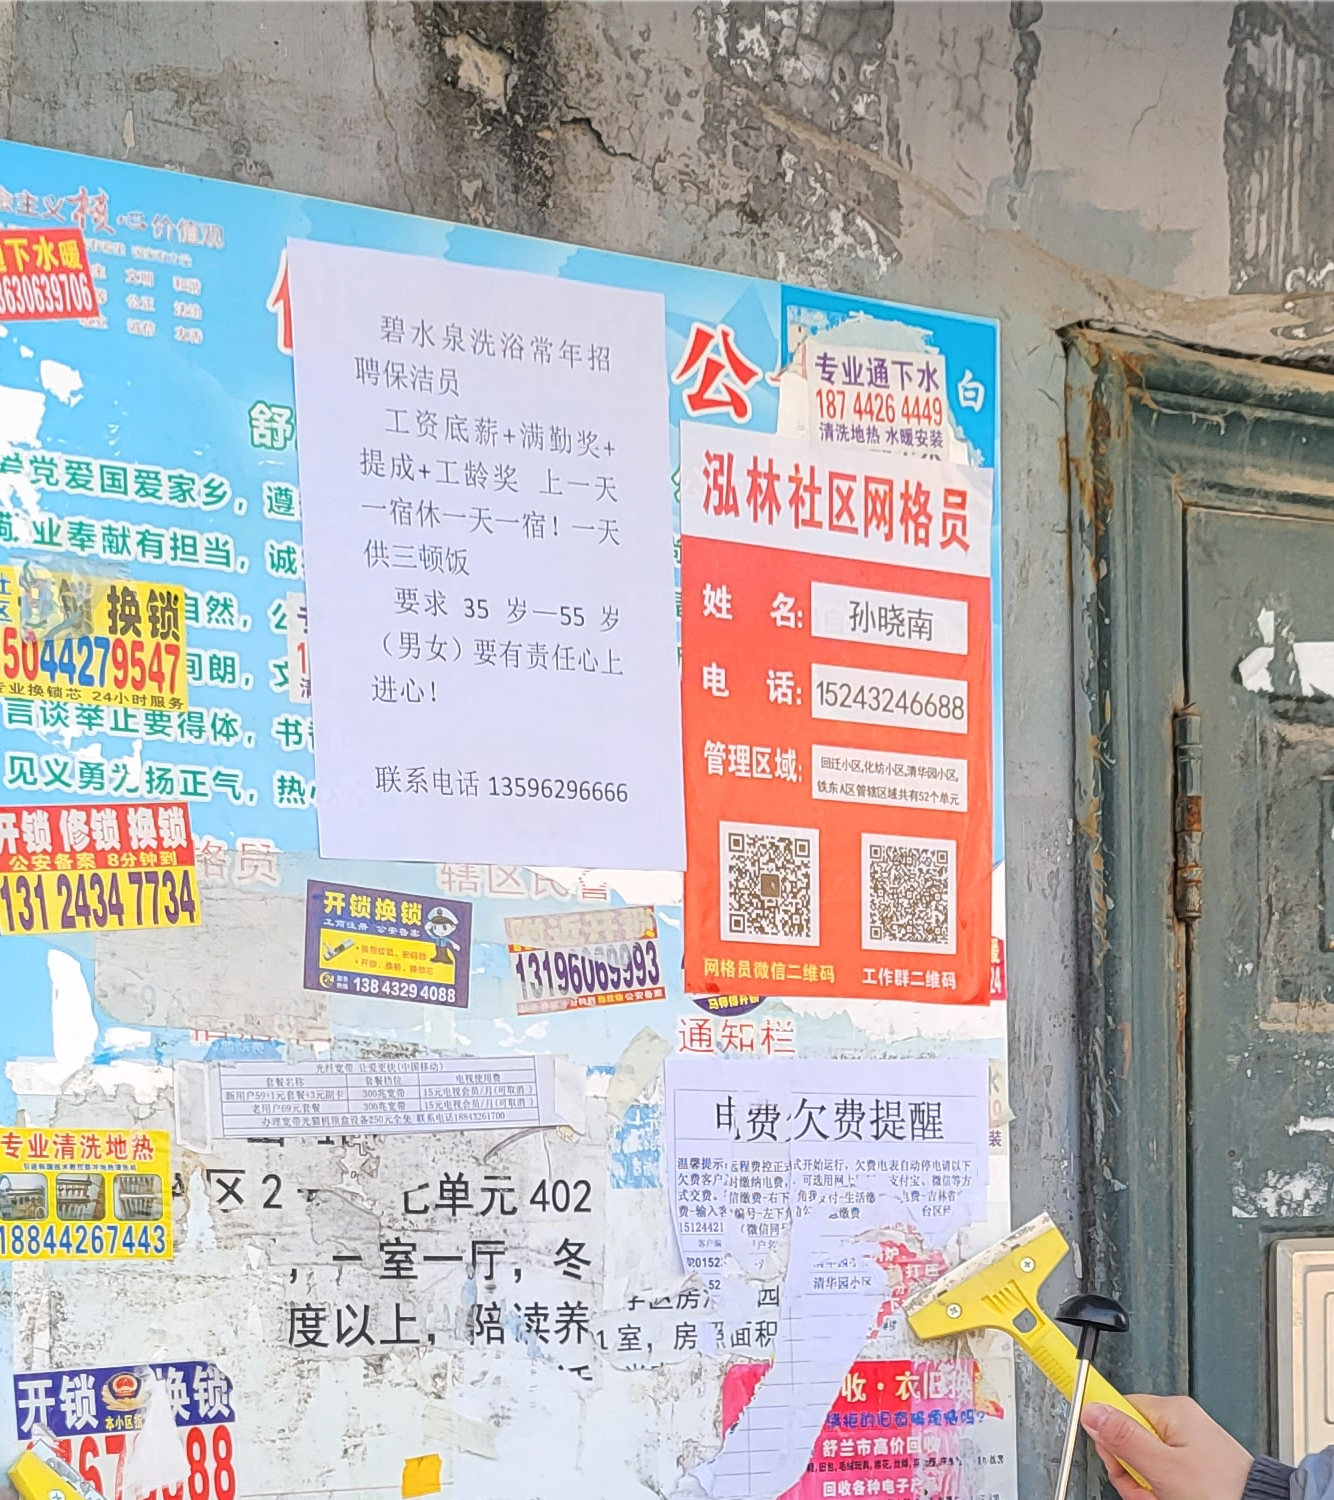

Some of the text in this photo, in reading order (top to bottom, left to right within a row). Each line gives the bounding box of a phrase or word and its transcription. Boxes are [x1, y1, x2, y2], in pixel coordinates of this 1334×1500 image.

[379, 314, 612, 374] 碧水泉洗浴常年招
[354, 355, 460, 398] 聘保洁员
[815, 352, 941, 393] 专业通下水
[816, 388, 944, 427] 187 4426 4449
[384, 407, 617, 461] 工资底薪+满勤奖+
[819, 421, 945, 450] 清洗地热 水暖安装
[359, 447, 618, 503] 提成+工龄奖 上一天
[702, 450, 971, 553] 泓林社区网格员
[363, 538, 470, 577] 供三顿饭
[107, 585, 181, 642] 换锁
[393, 585, 448, 617] 要求
[463, 597, 490, 621] 35
[599, 604, 621, 634] 岁
[702, 584, 935, 643] 姓 名: 孙晓南
[380, 630, 625, 678] （男女）要有责任心上
[92, 691, 184, 711] 24小时服务
[371, 674, 438, 705] 进心！
[701, 661, 966, 722] 电 话: 15243246688
[703, 740, 804, 784] 管理区域:
[375, 765, 629, 804] 联系电话 13596296666
[59, 807, 121, 852] 修锁
[127, 805, 188, 850] 换锁
[9, 850, 178, 871] 公安备案 8分钟到
[0, 869, 196, 932] 131 2434 7734
[323, 891, 423, 926] 开锁换锁
[353, 977, 380, 994] 138
[381, 980, 418, 999] 4329
[419, 985, 457, 1003] 4088
[703, 957, 958, 991] 网格员微信二维码 工作群二维码
[678, 1018, 797, 1056] 通知栏
[362, 1088, 406, 1100] 300兆宽带
[363, 1101, 407, 1112] 300兆宽带
[716, 1096, 945, 1143] 电费欠费提醒
[0, 1132, 155, 1161] 专业清洗地热
[529, 1178, 593, 1214] 402
[17, 1373, 100, 1433] 开锁
[822, 1436, 941, 1458] 舒兰市高价回收
